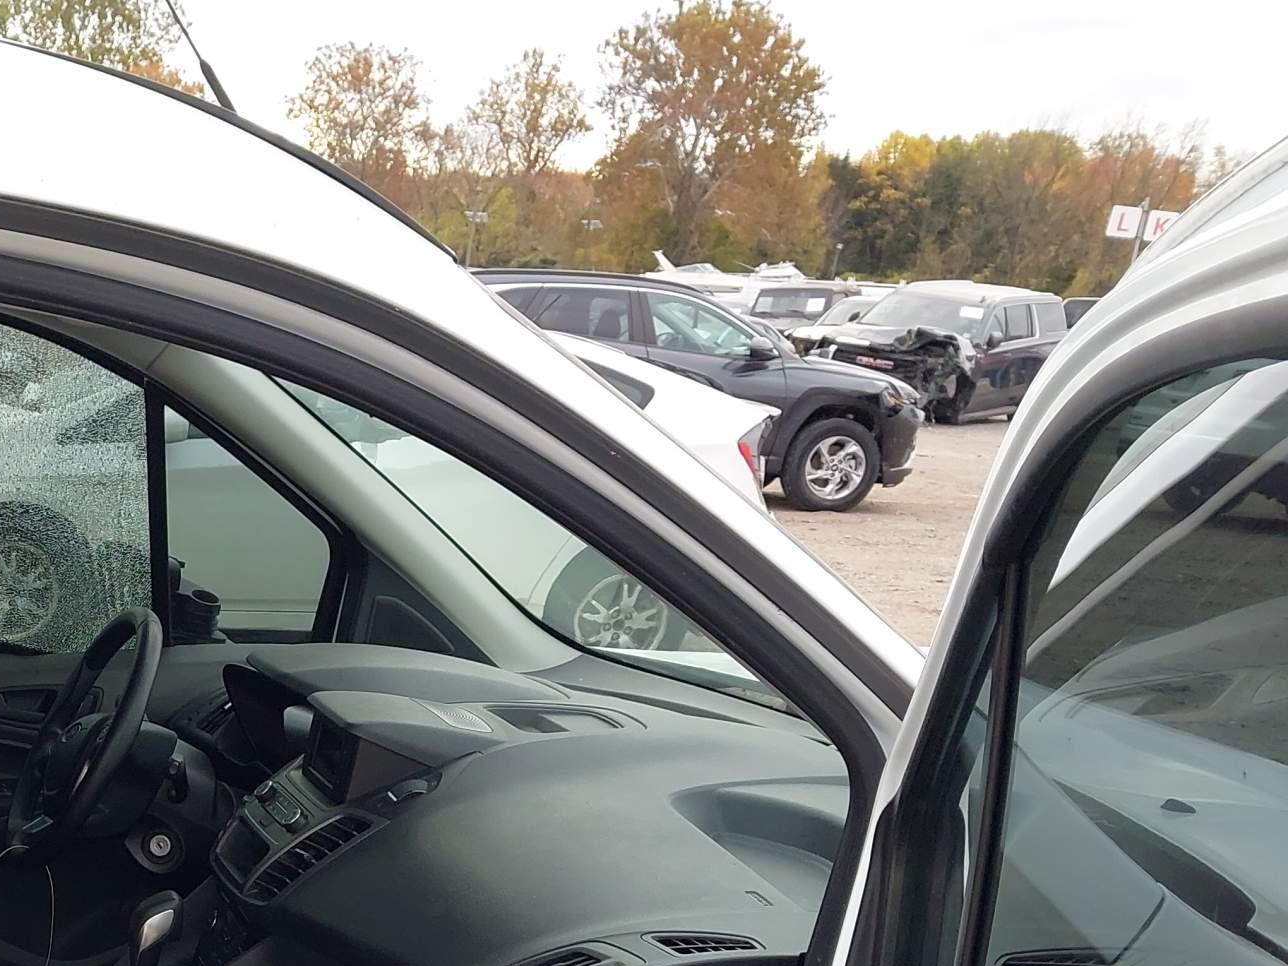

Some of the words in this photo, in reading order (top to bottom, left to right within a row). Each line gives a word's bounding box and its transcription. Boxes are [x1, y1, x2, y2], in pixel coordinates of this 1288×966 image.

[1116, 212, 1128, 231] L
[1153, 217, 1172, 236] K
[855, 355, 893, 370] GMC
